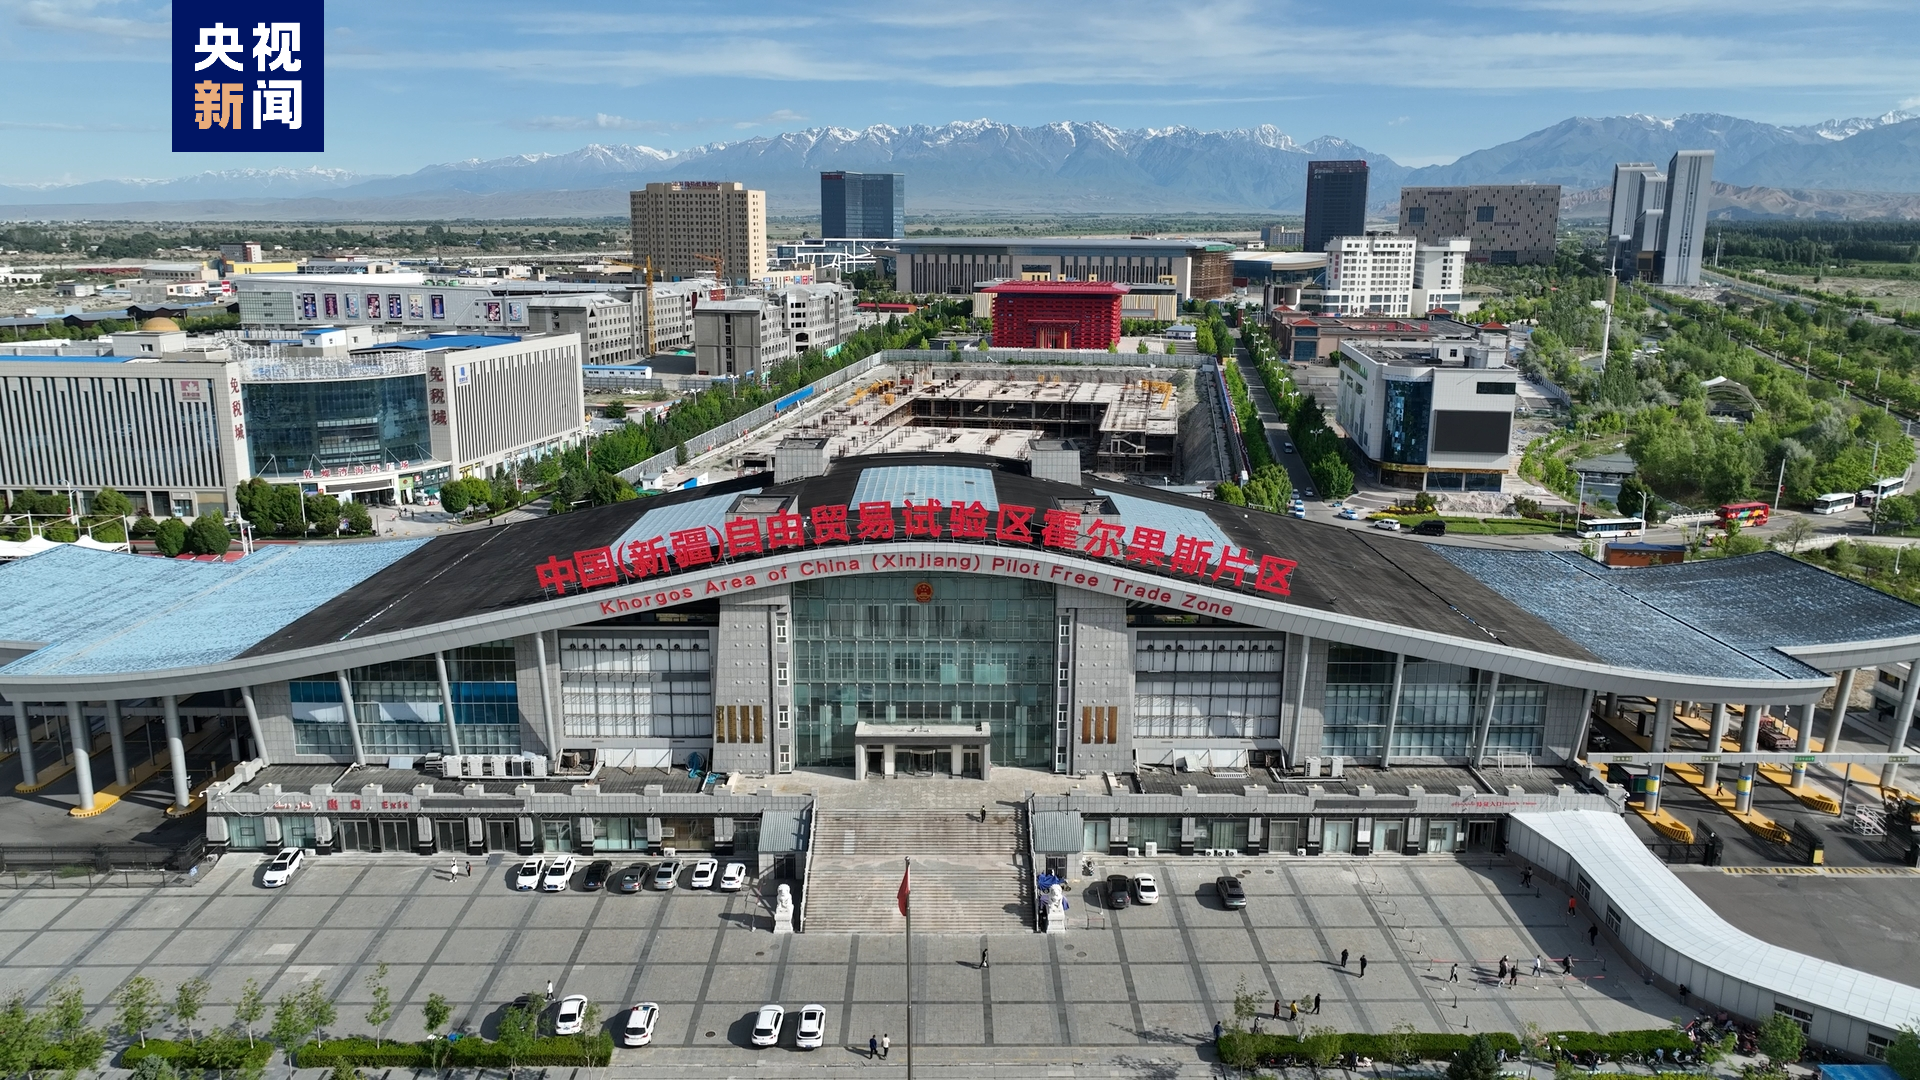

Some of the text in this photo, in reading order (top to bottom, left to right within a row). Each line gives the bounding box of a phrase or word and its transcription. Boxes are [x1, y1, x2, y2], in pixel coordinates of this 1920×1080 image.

[230, 377, 245, 441] 免税城
[429, 366, 447, 426] 免税城
[600, 553, 1233, 617] Khorgos Area of China (Xinjiang) Pilot Free Trade Zone
[381, 800, 409, 810] Exit
